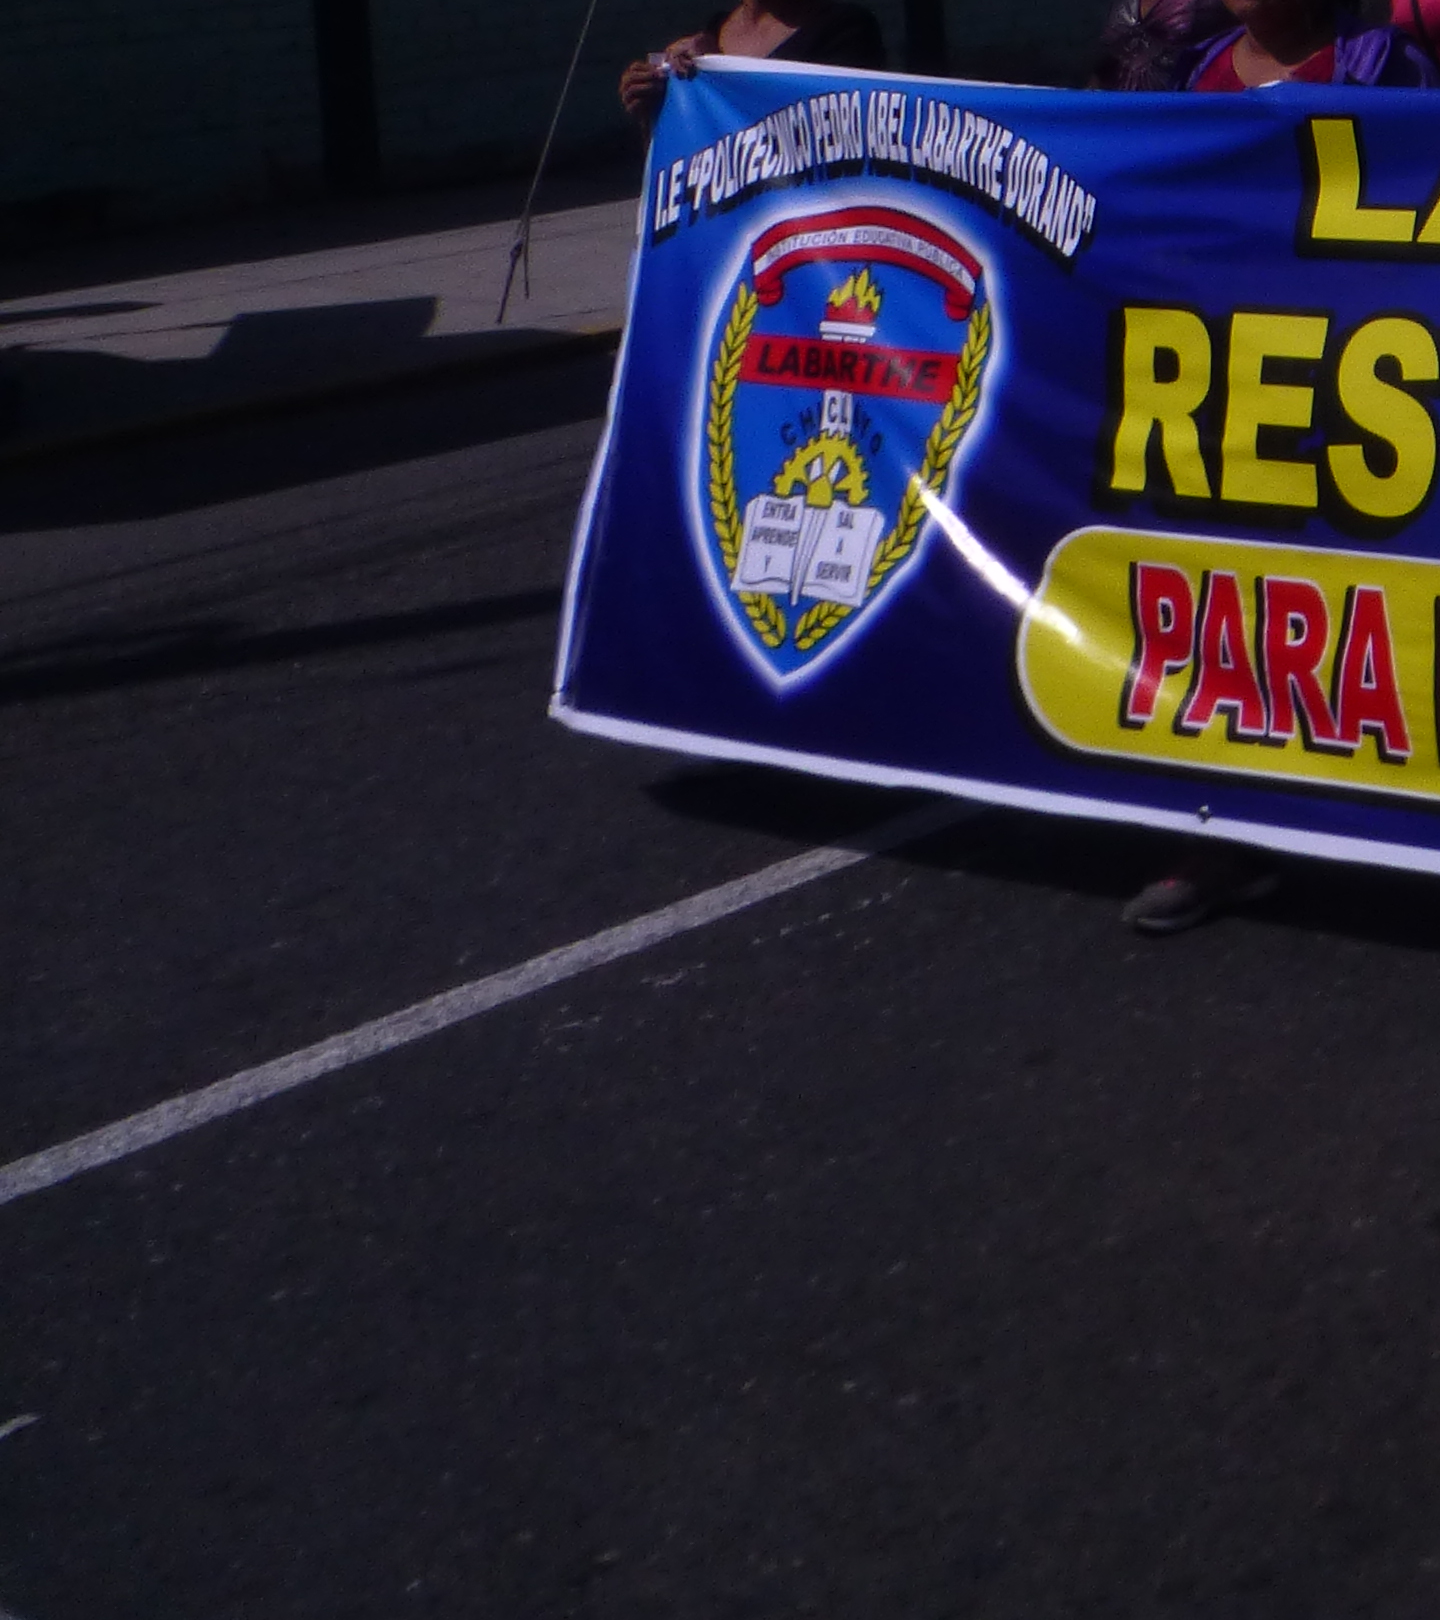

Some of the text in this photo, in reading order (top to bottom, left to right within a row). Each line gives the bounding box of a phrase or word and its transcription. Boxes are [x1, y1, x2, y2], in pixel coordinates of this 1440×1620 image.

[809, 90, 864, 166] PEDRO
[866, 90, 910, 164] ABEL
[911, 96, 1014, 202] LABARTHE
[757, 343, 942, 392] LABARTHE
[761, 501, 797, 521] ENTRA
[1123, 563, 1412, 760] PARA
